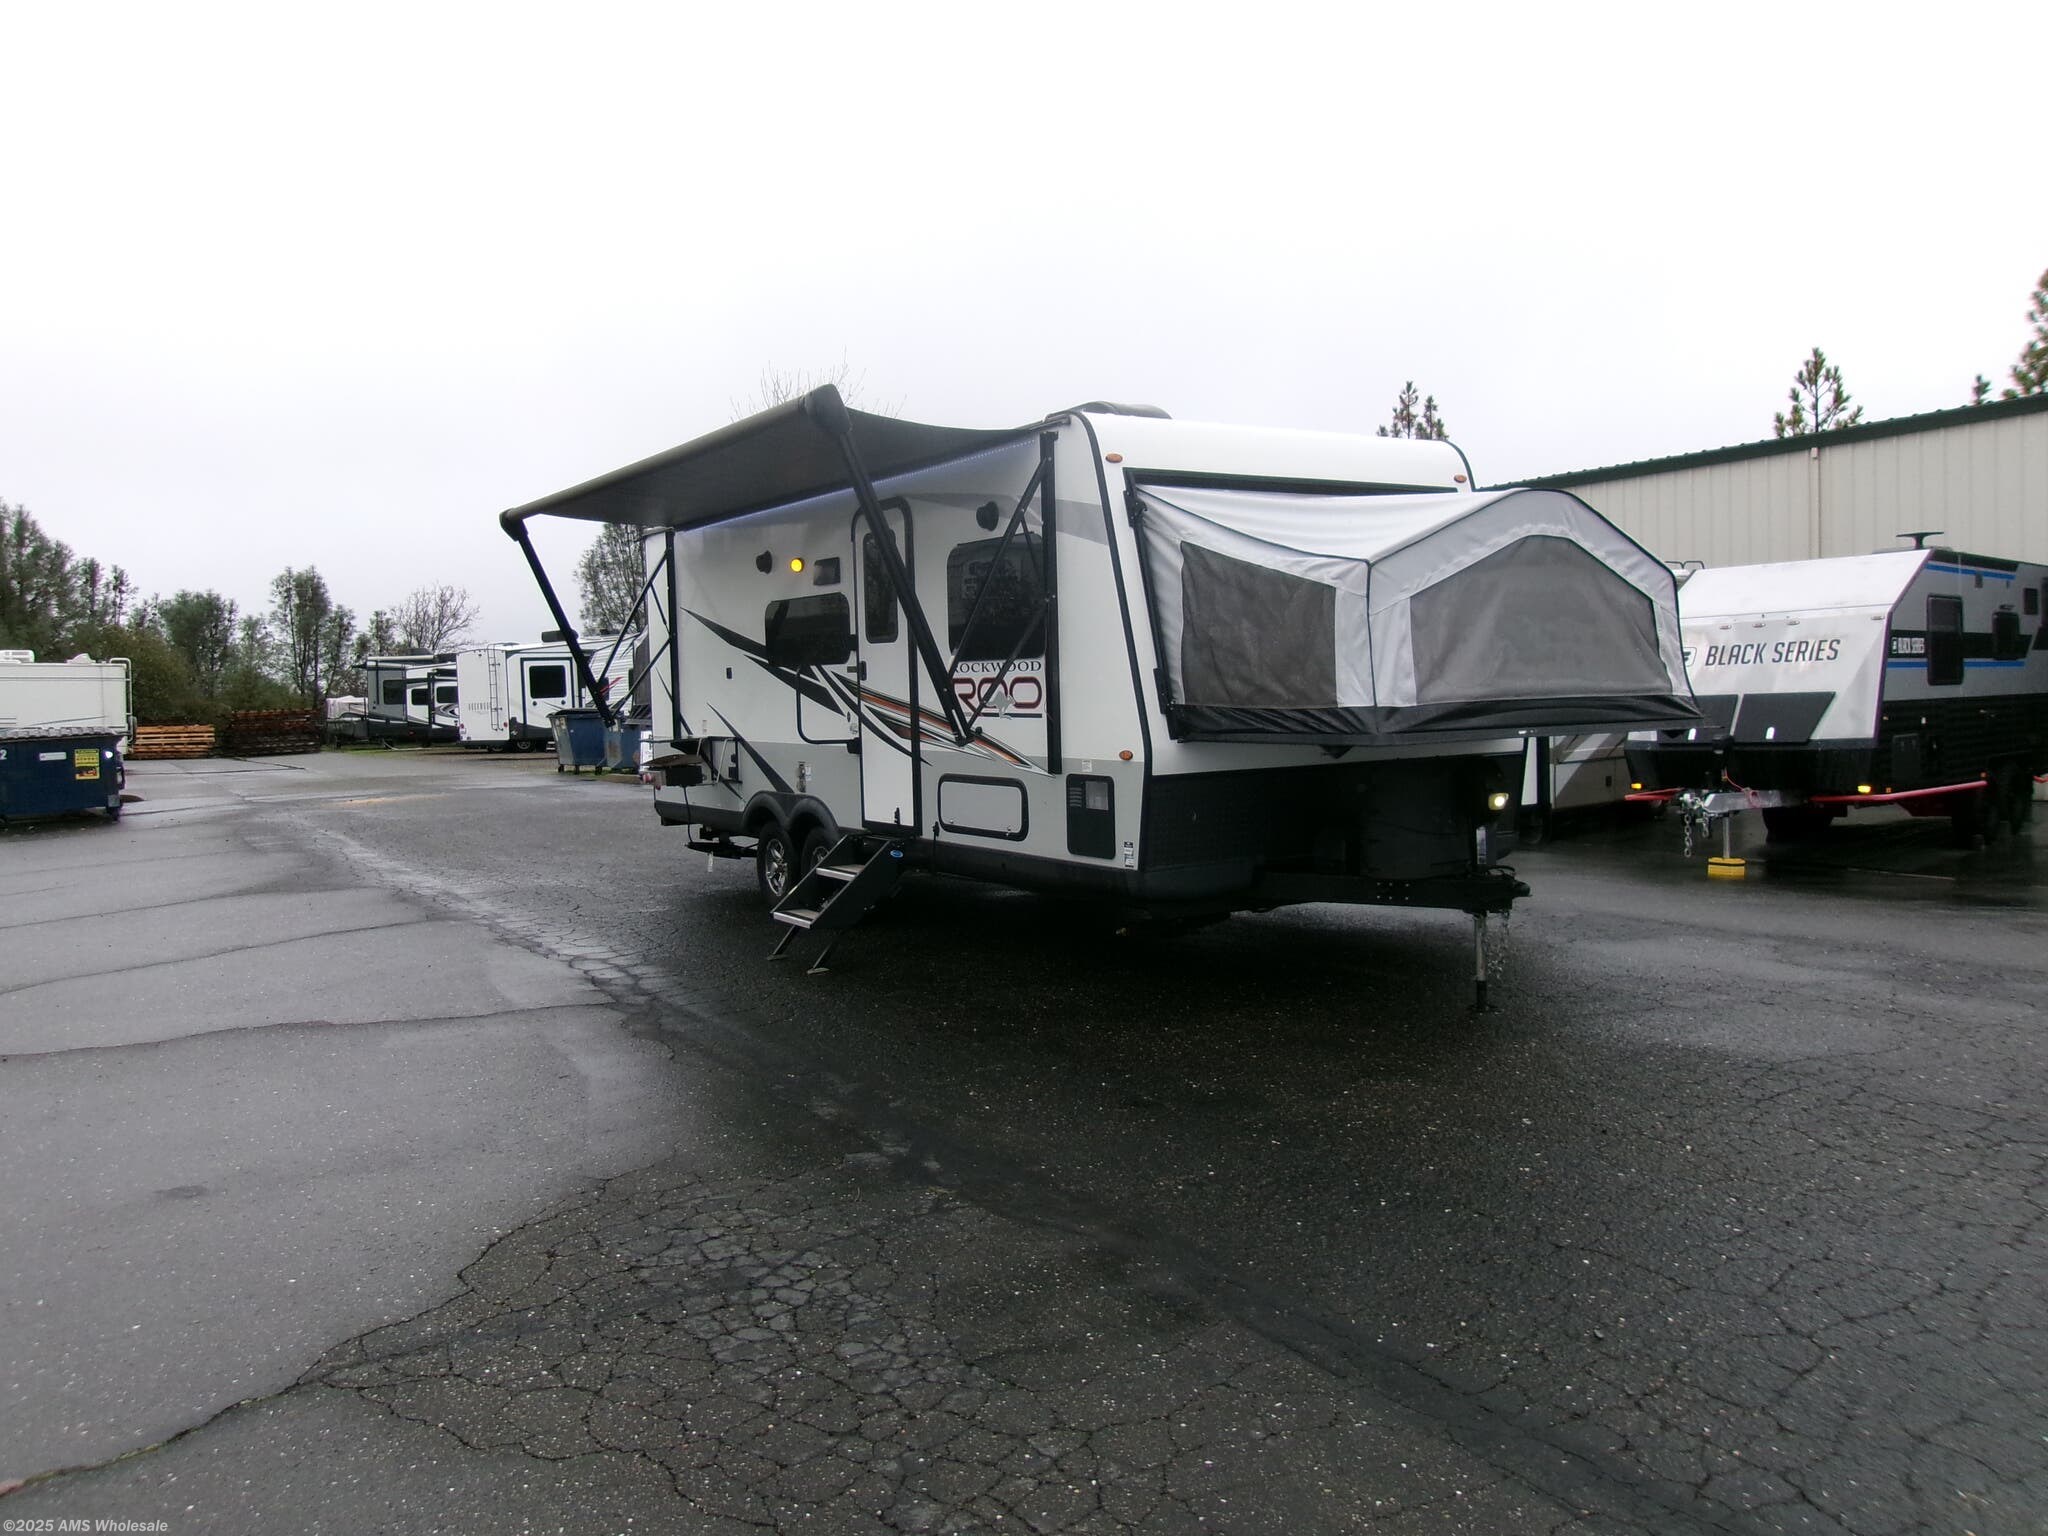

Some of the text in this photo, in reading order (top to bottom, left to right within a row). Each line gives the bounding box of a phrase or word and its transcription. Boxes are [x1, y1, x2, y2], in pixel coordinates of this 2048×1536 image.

[1705, 643, 1767, 666] BLACK
[1772, 639, 1841, 663] SERIES
[954, 660, 1042, 674] OCKWOOD
